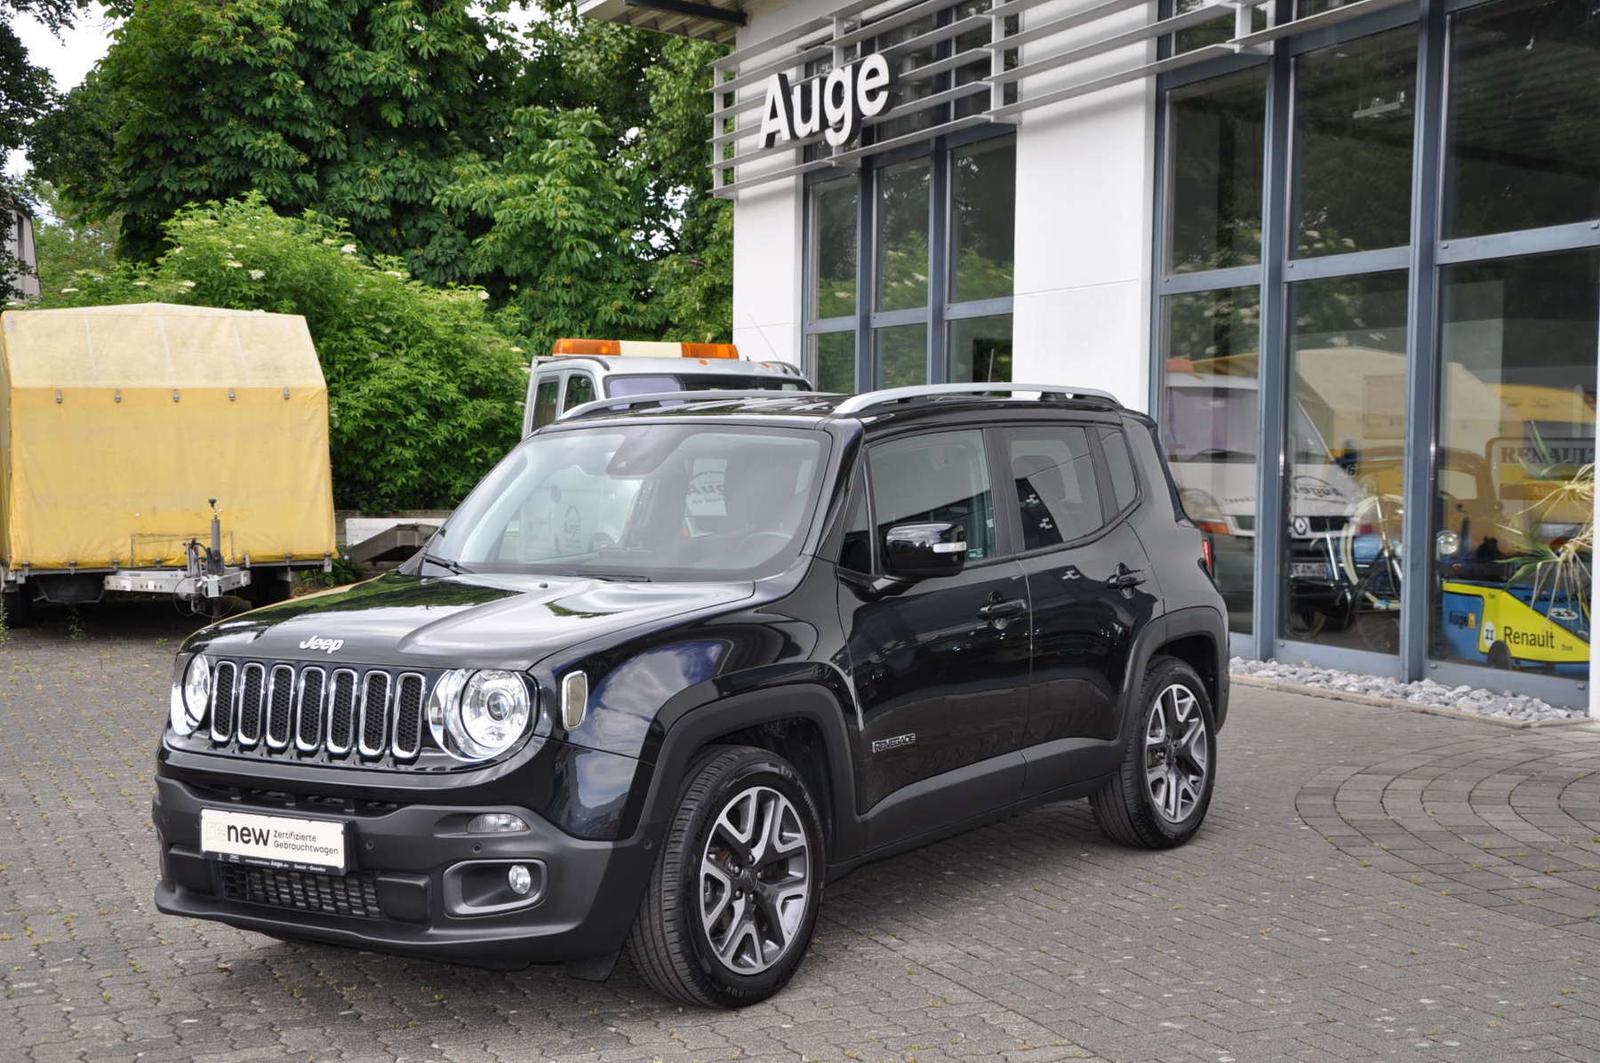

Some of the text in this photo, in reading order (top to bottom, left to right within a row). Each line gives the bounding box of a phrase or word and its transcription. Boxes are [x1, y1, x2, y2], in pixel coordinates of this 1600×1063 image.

[759, 53, 890, 149] Auge
[299, 635, 344, 654] Jeep
[1503, 625, 1555, 649] Renault
[273, 829, 317, 843] Zertifizierte
[273, 839, 339, 856] Gebrauchtwagen
